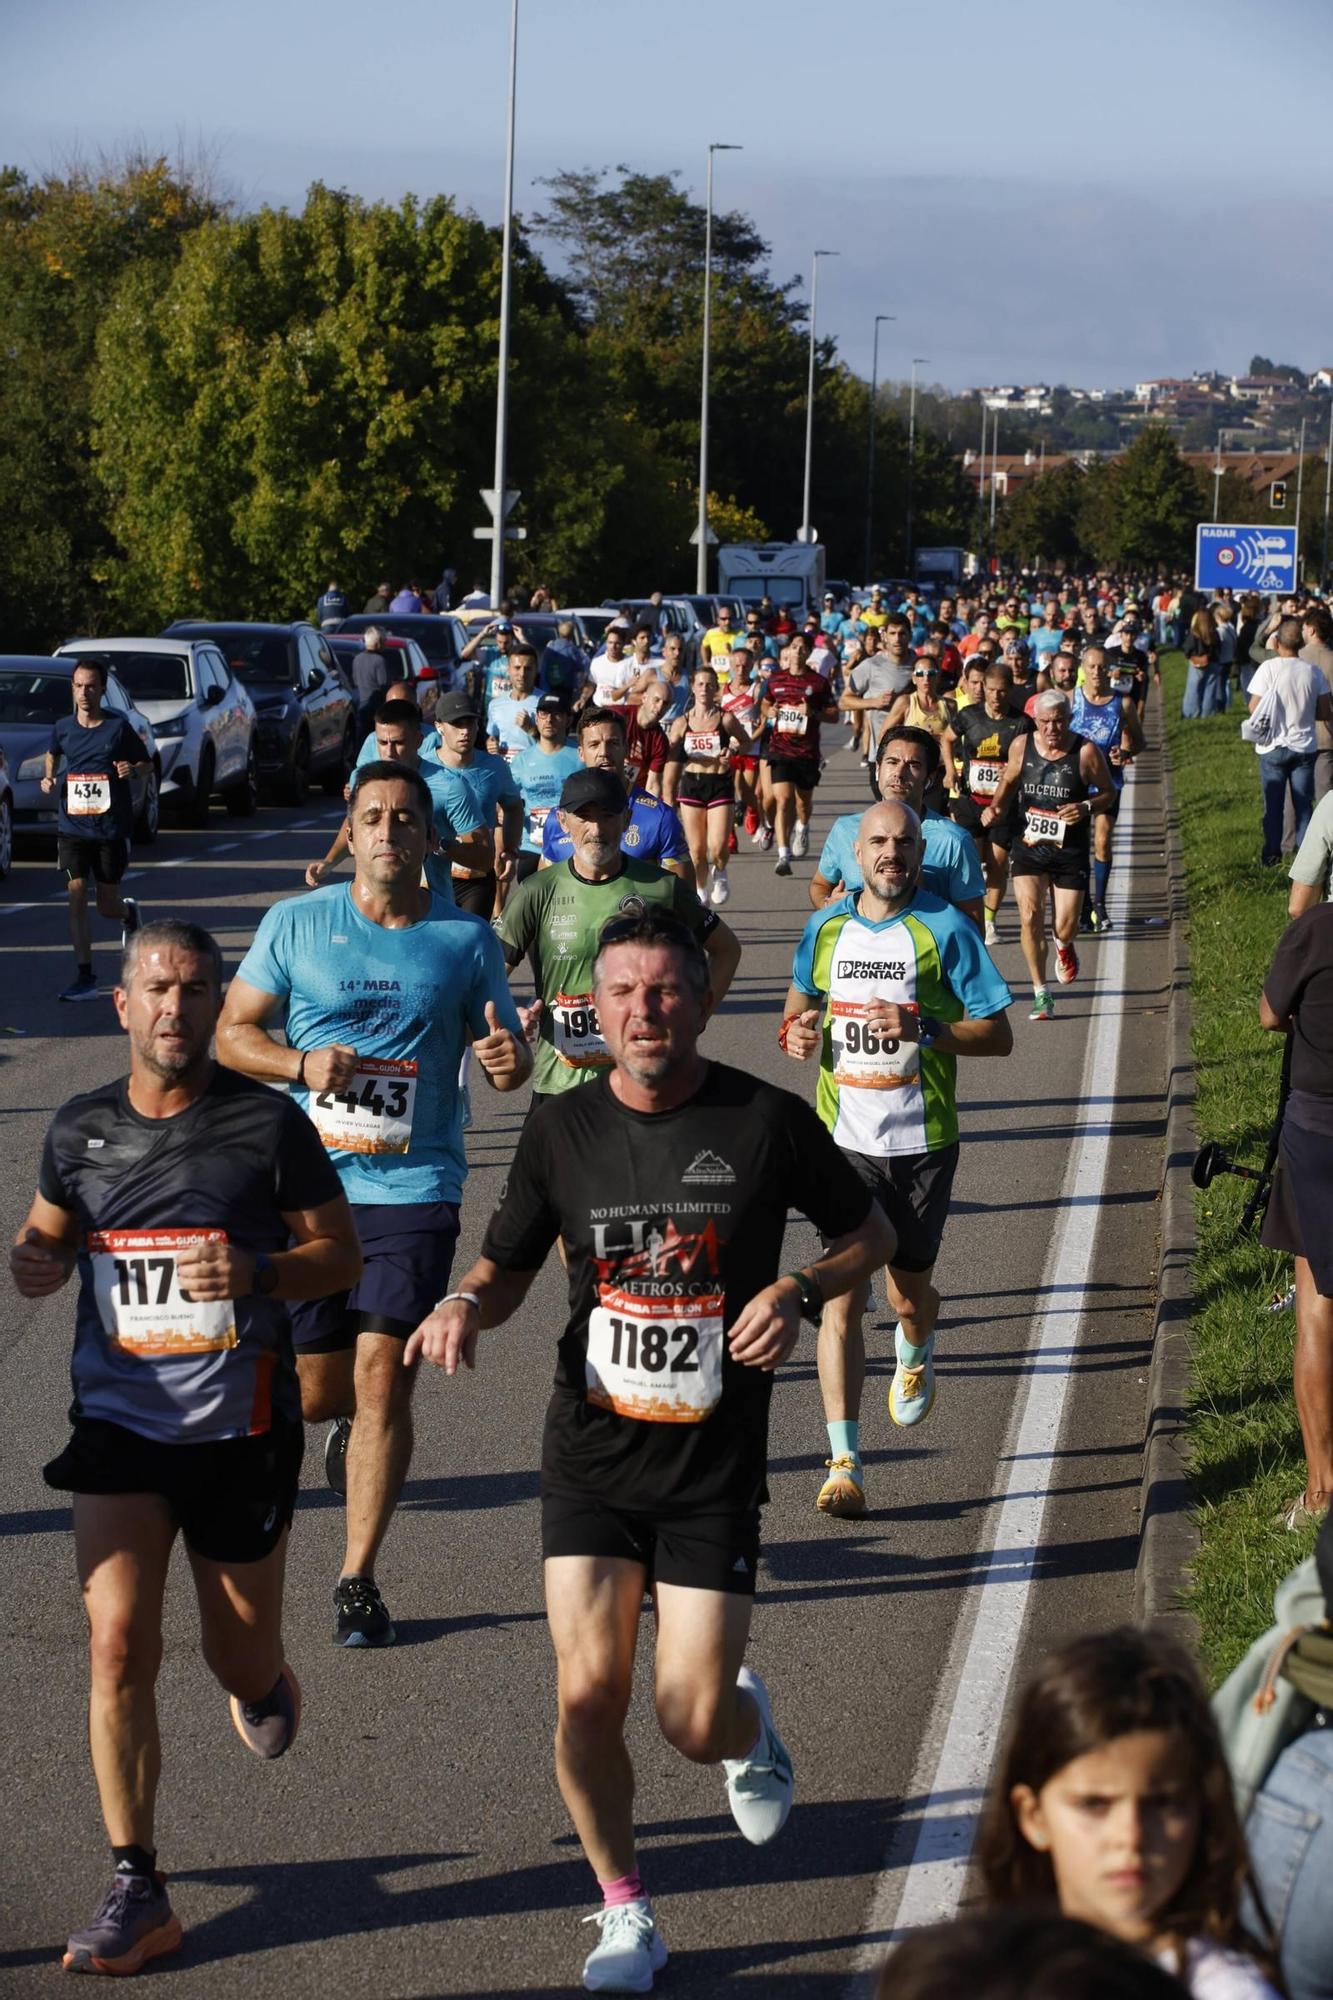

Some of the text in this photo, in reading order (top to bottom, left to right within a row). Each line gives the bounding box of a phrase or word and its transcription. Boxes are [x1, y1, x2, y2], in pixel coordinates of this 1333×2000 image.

[1202, 529, 1236, 538] RADAR
[691, 739, 713, 750] 365
[74, 783, 102, 798] 434
[1036, 784, 1071, 798] CERNE
[852, 970, 906, 980] CONTACT
[363, 981, 400, 991] MBA
[354, 996, 400, 1008] media
[316, 1079, 410, 1118] 2443
[590, 1203, 731, 1219] NO HUMAN IS LIMITED
[127, 1237, 155, 1247] MBA
[114, 1258, 200, 1304] 117
[624, 1301, 650, 1314] MBA
[610, 1318, 699, 1373] 1182
